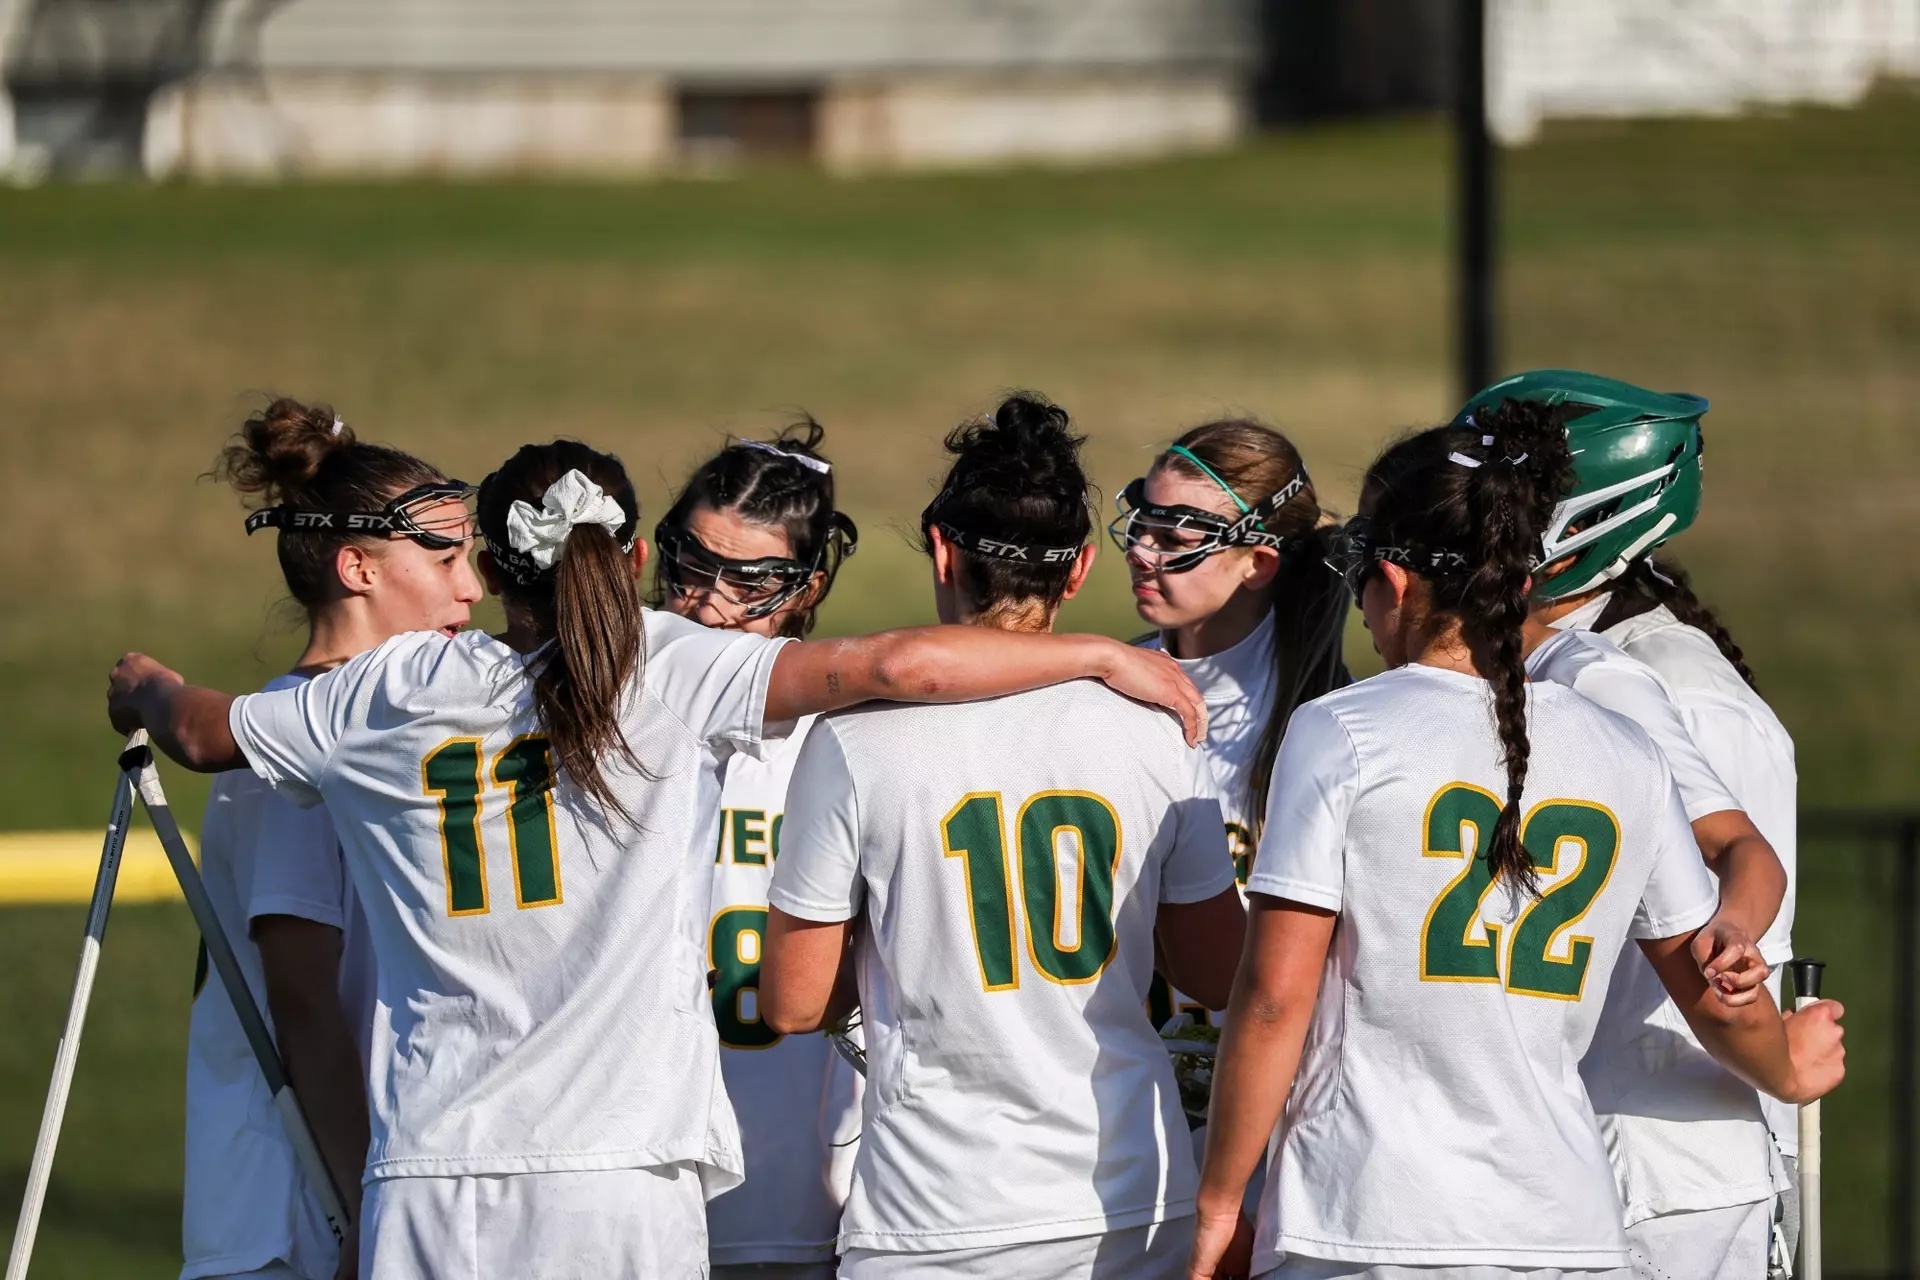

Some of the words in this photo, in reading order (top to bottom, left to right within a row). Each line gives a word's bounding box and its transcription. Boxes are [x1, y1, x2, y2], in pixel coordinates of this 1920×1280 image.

[1271, 473, 1304, 510] STX
[294, 512, 334, 527] STX
[346, 514, 395, 529] STX
[1227, 508, 1264, 543] STX
[976, 537, 1029, 560] STX
[1042, 545, 1079, 562] STX
[1243, 530, 1285, 548] STX
[1374, 546, 1411, 562] STX
[421, 733, 564, 918] 11
[939, 789, 1123, 993] 10
[1419, 780, 1623, 1002] 22
